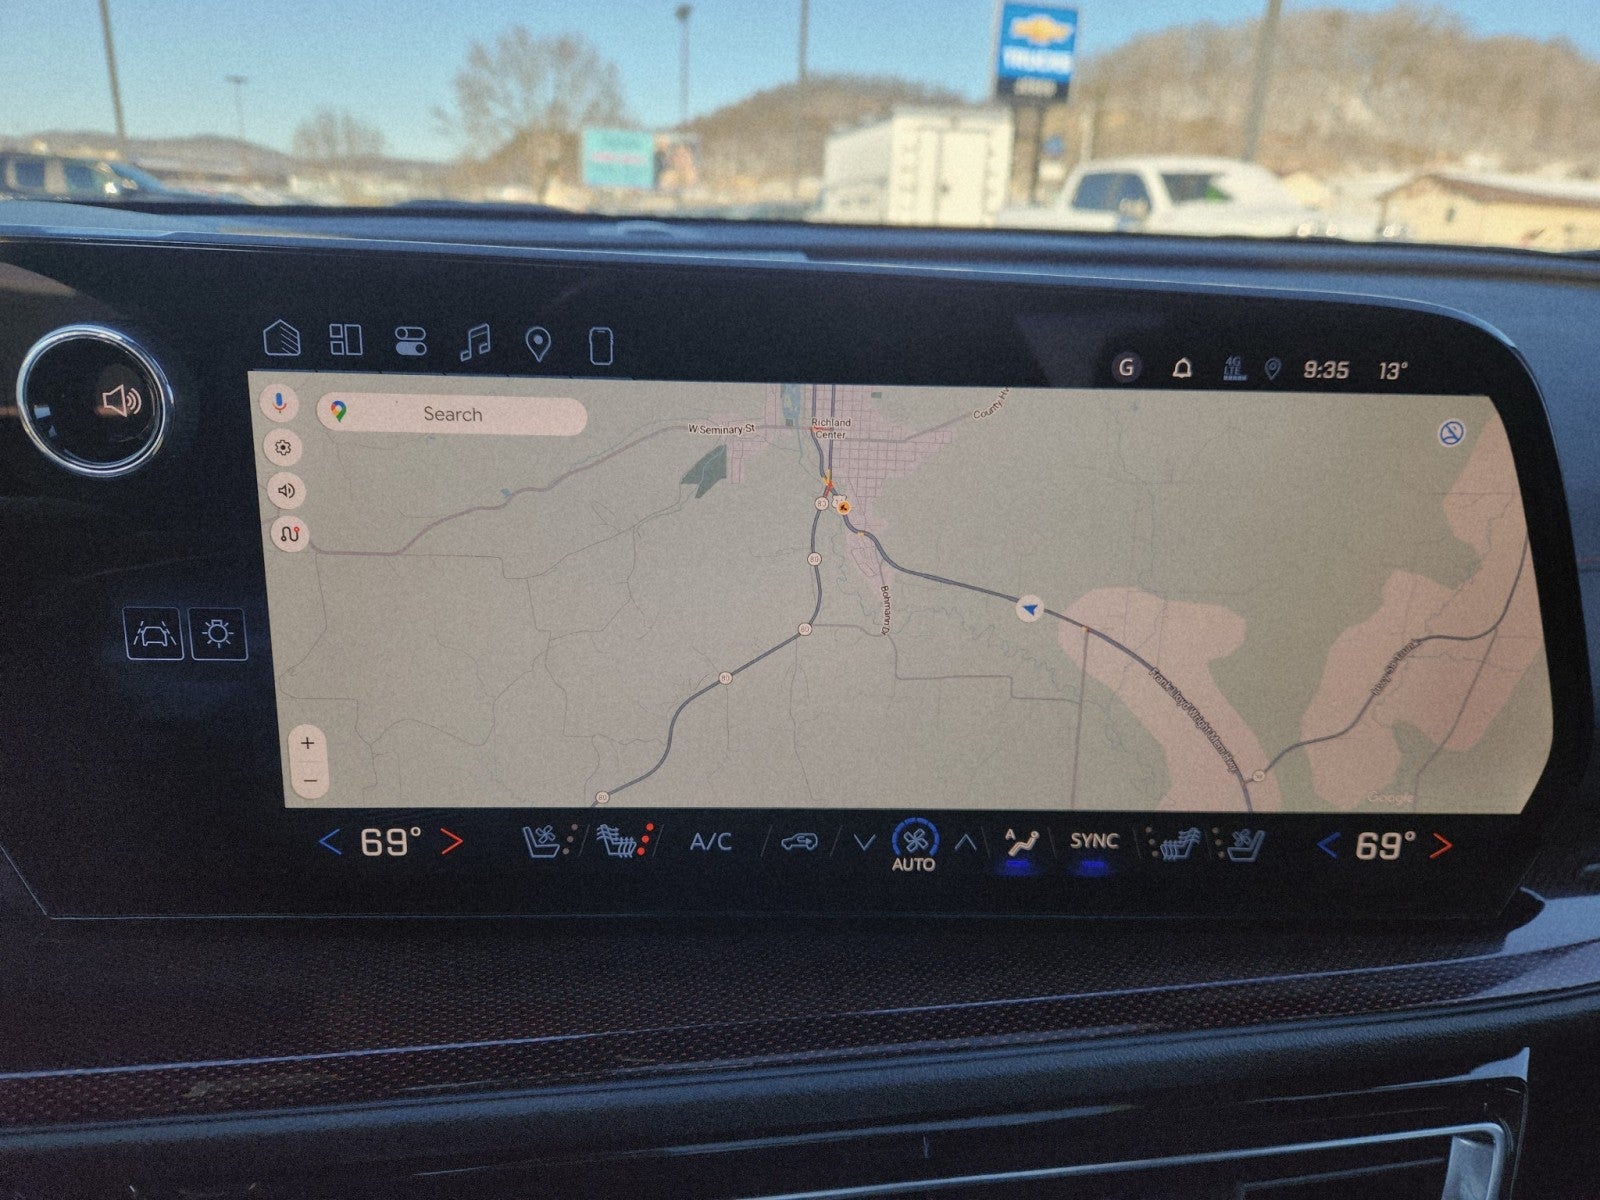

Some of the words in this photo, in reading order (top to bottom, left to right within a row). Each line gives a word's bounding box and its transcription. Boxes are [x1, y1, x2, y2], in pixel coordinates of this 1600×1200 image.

[1118, 358, 1134, 376] G
[1225, 356, 1241, 366] 4G
[1304, 360, 1350, 380] 9:35
[1223, 366, 1242, 376] LTE
[1378, 361, 1409, 381] 13°
[424, 405, 483, 423] Search
[973, 400, 1003, 419] County
[688, 424, 698, 433] W
[699, 425, 743, 436] Seminary
[745, 424, 755, 433] St
[811, 418, 851, 427] Richland
[815, 430, 846, 439] Center
[880, 585, 891, 626] Bohmann
[1149, 667, 1174, 692] Frank
[1188, 703, 1212, 737] Wright
[360, 826, 422, 857] 69°
[689, 832, 733, 851] A/C
[1069, 832, 1121, 850] SYNC
[1355, 830, 1417, 862] 69°
[891, 856, 937, 873] AUTO
